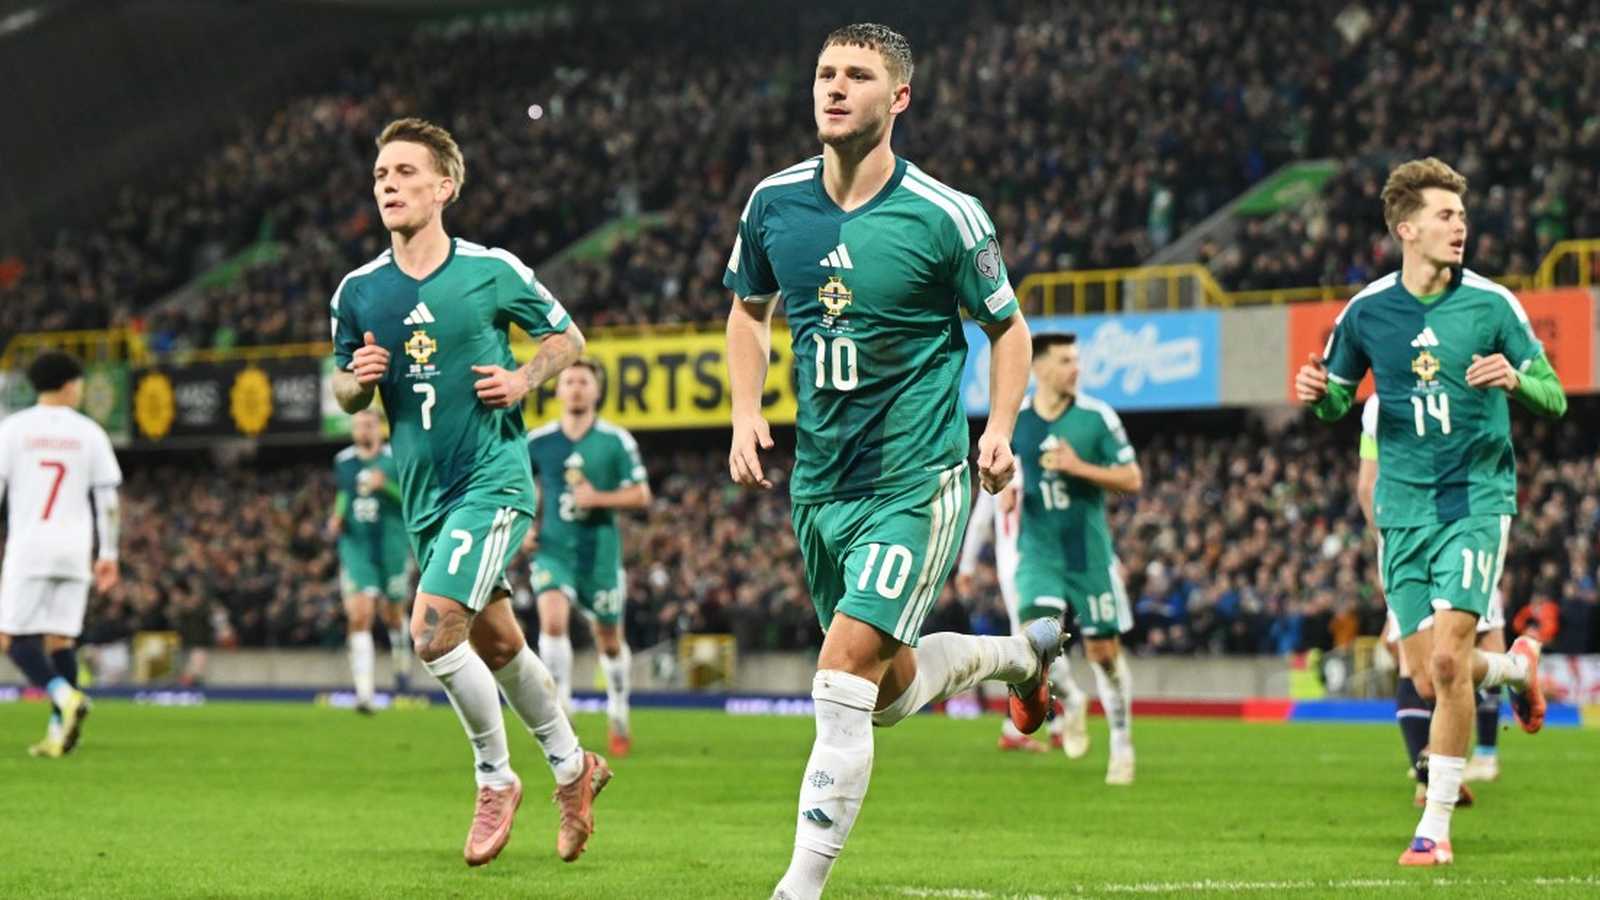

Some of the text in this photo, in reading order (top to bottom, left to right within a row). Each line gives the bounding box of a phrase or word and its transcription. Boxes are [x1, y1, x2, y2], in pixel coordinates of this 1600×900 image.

[813, 333, 858, 391] 10
[412, 382, 436, 430] 7
[1411, 392, 1451, 437] 14
[39, 459, 66, 521] 7
[1039, 479, 1071, 511] 16
[447, 528, 473, 576] 7
[857, 543, 913, 600] 10
[1461, 547, 1493, 595] 14
[1087, 591, 1116, 623] 16
